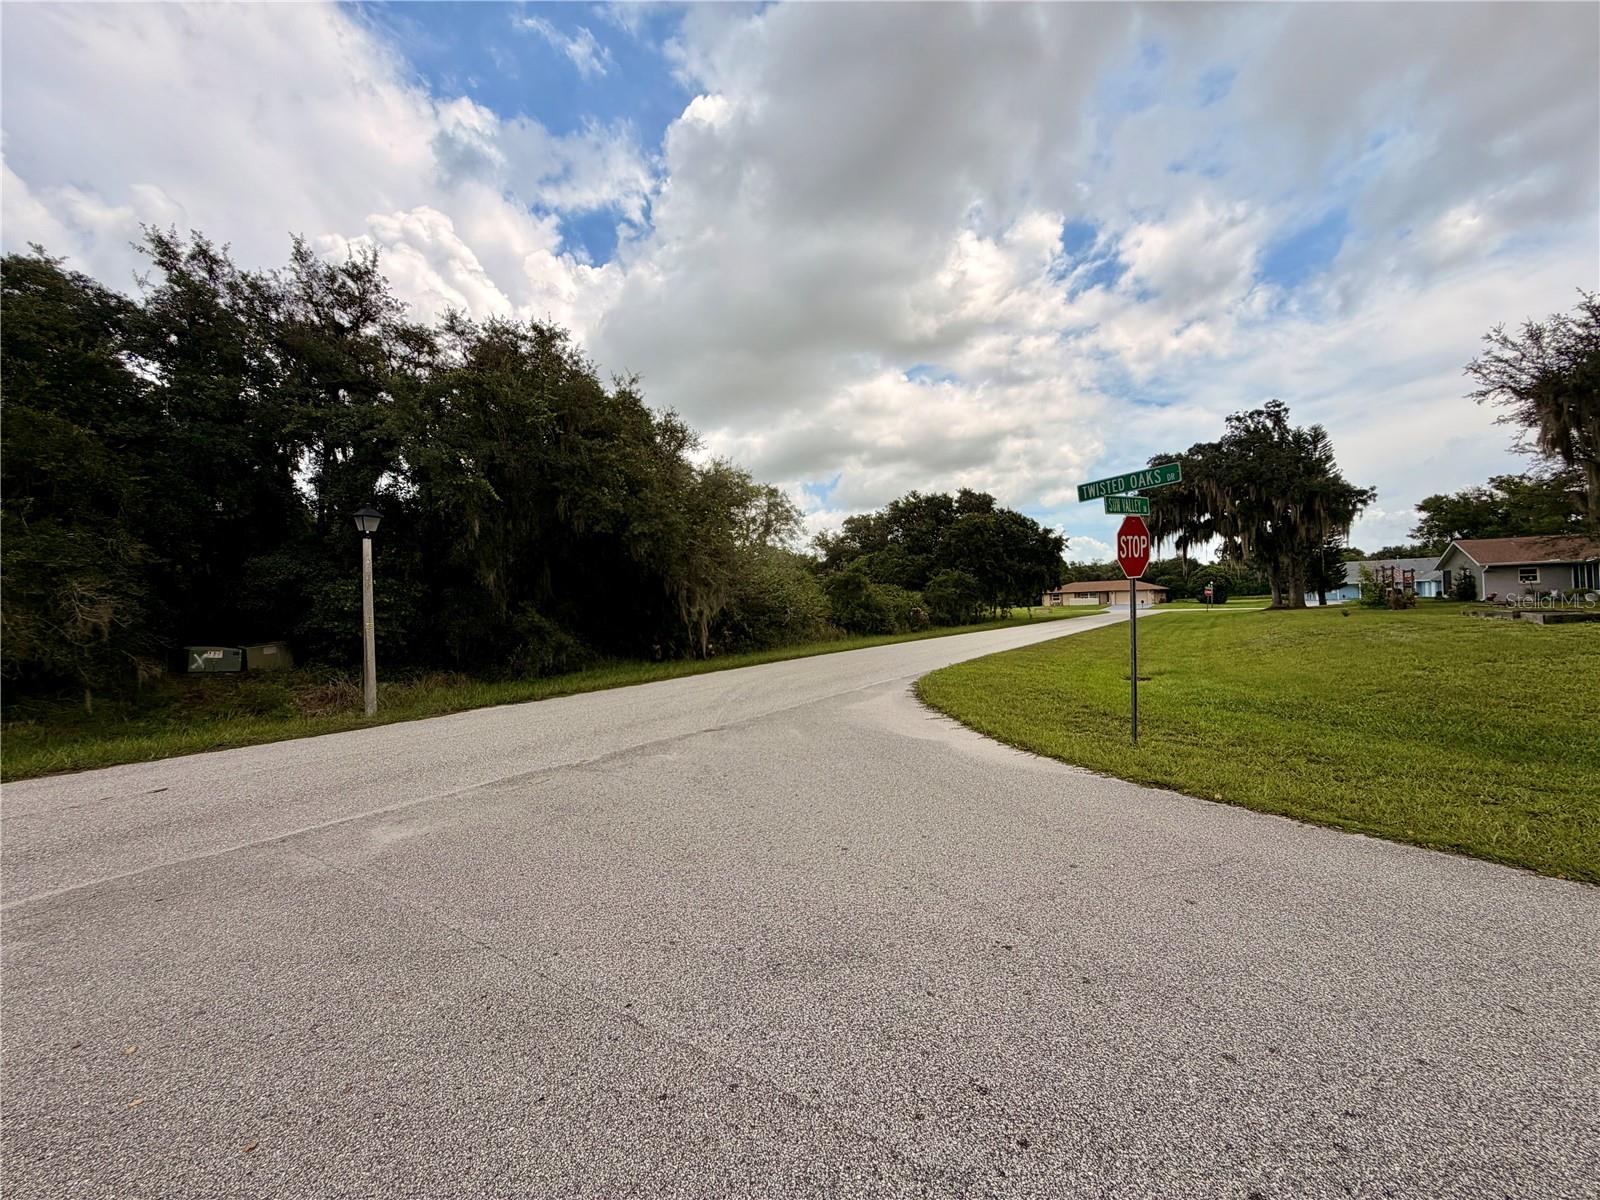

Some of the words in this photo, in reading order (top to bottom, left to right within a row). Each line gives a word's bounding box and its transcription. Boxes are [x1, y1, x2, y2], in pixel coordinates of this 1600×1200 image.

[1082, 478, 1125, 499] TWISTED
[1129, 469, 1162, 489] OAKS
[1166, 473, 1175, 481] DR
[1109, 497, 1120, 511] SUN
[1122, 498, 1141, 512] VALLEY
[1120, 535, 1148, 558] STOP
